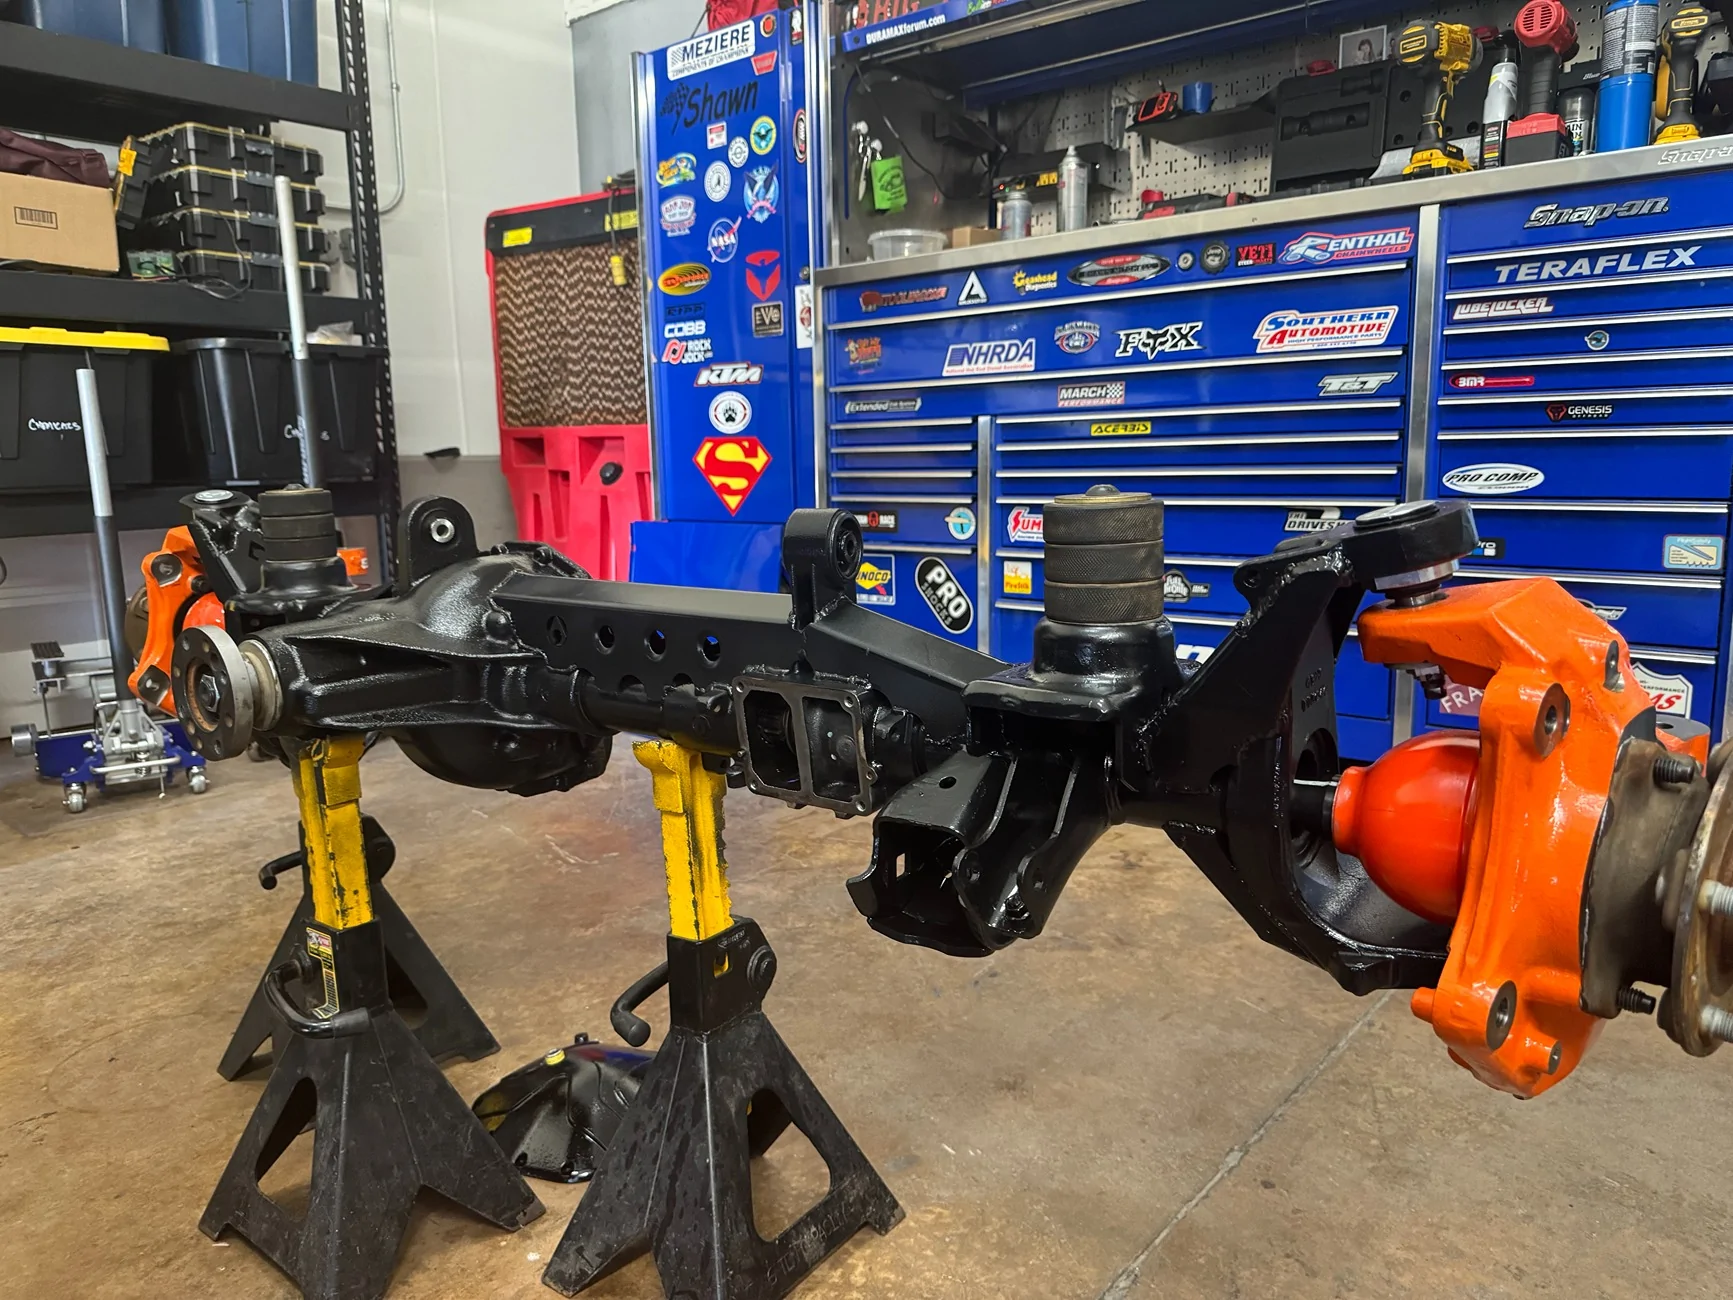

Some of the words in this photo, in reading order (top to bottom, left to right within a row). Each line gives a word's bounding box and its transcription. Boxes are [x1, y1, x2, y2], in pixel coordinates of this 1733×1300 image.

[866, 13, 946, 46] DURAMAXforum.com
[682, 24, 751, 62] MEZIERE
[684, 81, 758, 128] Shawn
[1524, 196, 1669, 229] Snap-on
[1238, 243, 1273, 261] YETI
[1495, 245, 1703, 284] TERAFLEX
[1453, 296, 1554, 321] LUBELOCKER
[663, 319, 707, 339] COBB
[960, 342, 1034, 366] NHRDA
[696, 362, 762, 385] KTM
[1058, 398, 1124, 408] PERFORMANCE
[1060, 386, 1107, 400] MARCH
[1568, 404, 1613, 415] GENESIS
[1446, 473, 1483, 483] PRO
[1483, 472, 1540, 482] COMP
[925, 564, 968, 620] PRO
